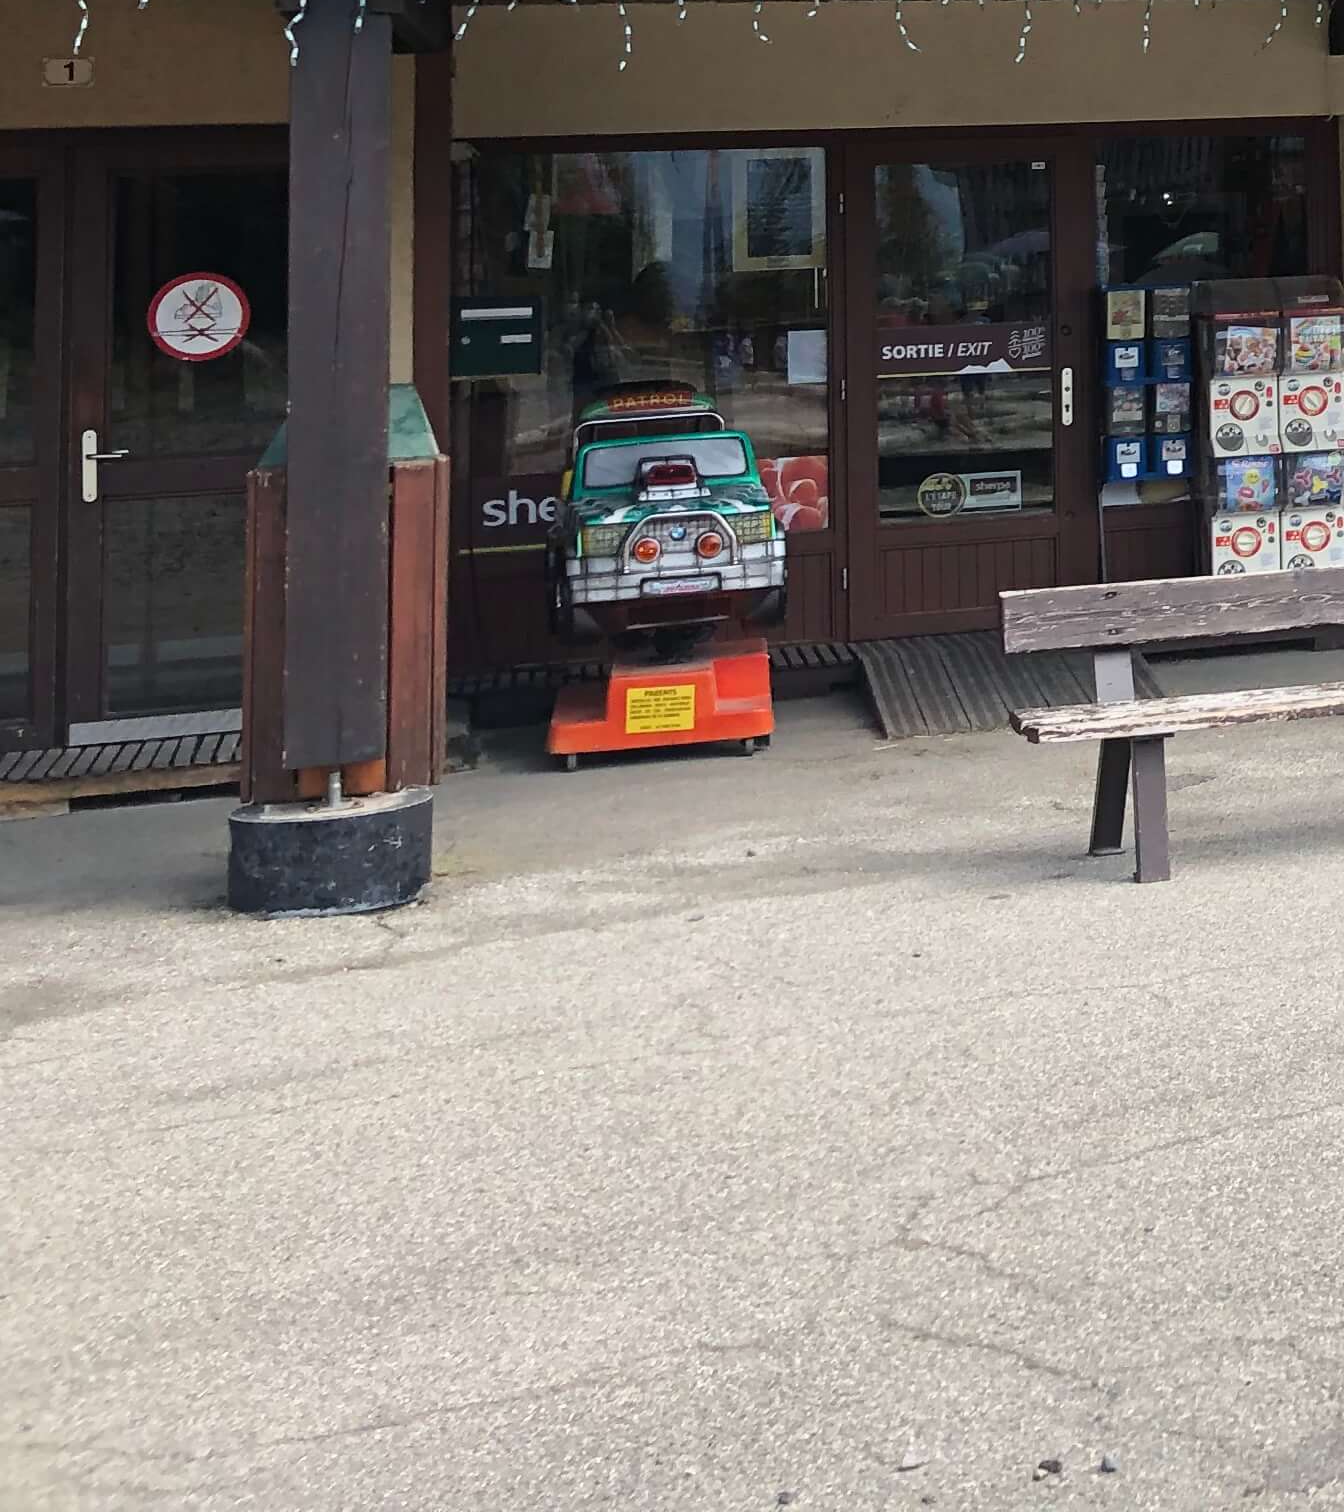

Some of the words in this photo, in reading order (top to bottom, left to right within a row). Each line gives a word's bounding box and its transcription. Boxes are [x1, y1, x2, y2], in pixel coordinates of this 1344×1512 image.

[63, 61, 75, 82] 1
[882, 343, 944, 360] SORTIE
[957, 342, 993, 357] EXIT
[613, 393, 689, 408] PATROL
[483, 490, 556, 527] she
